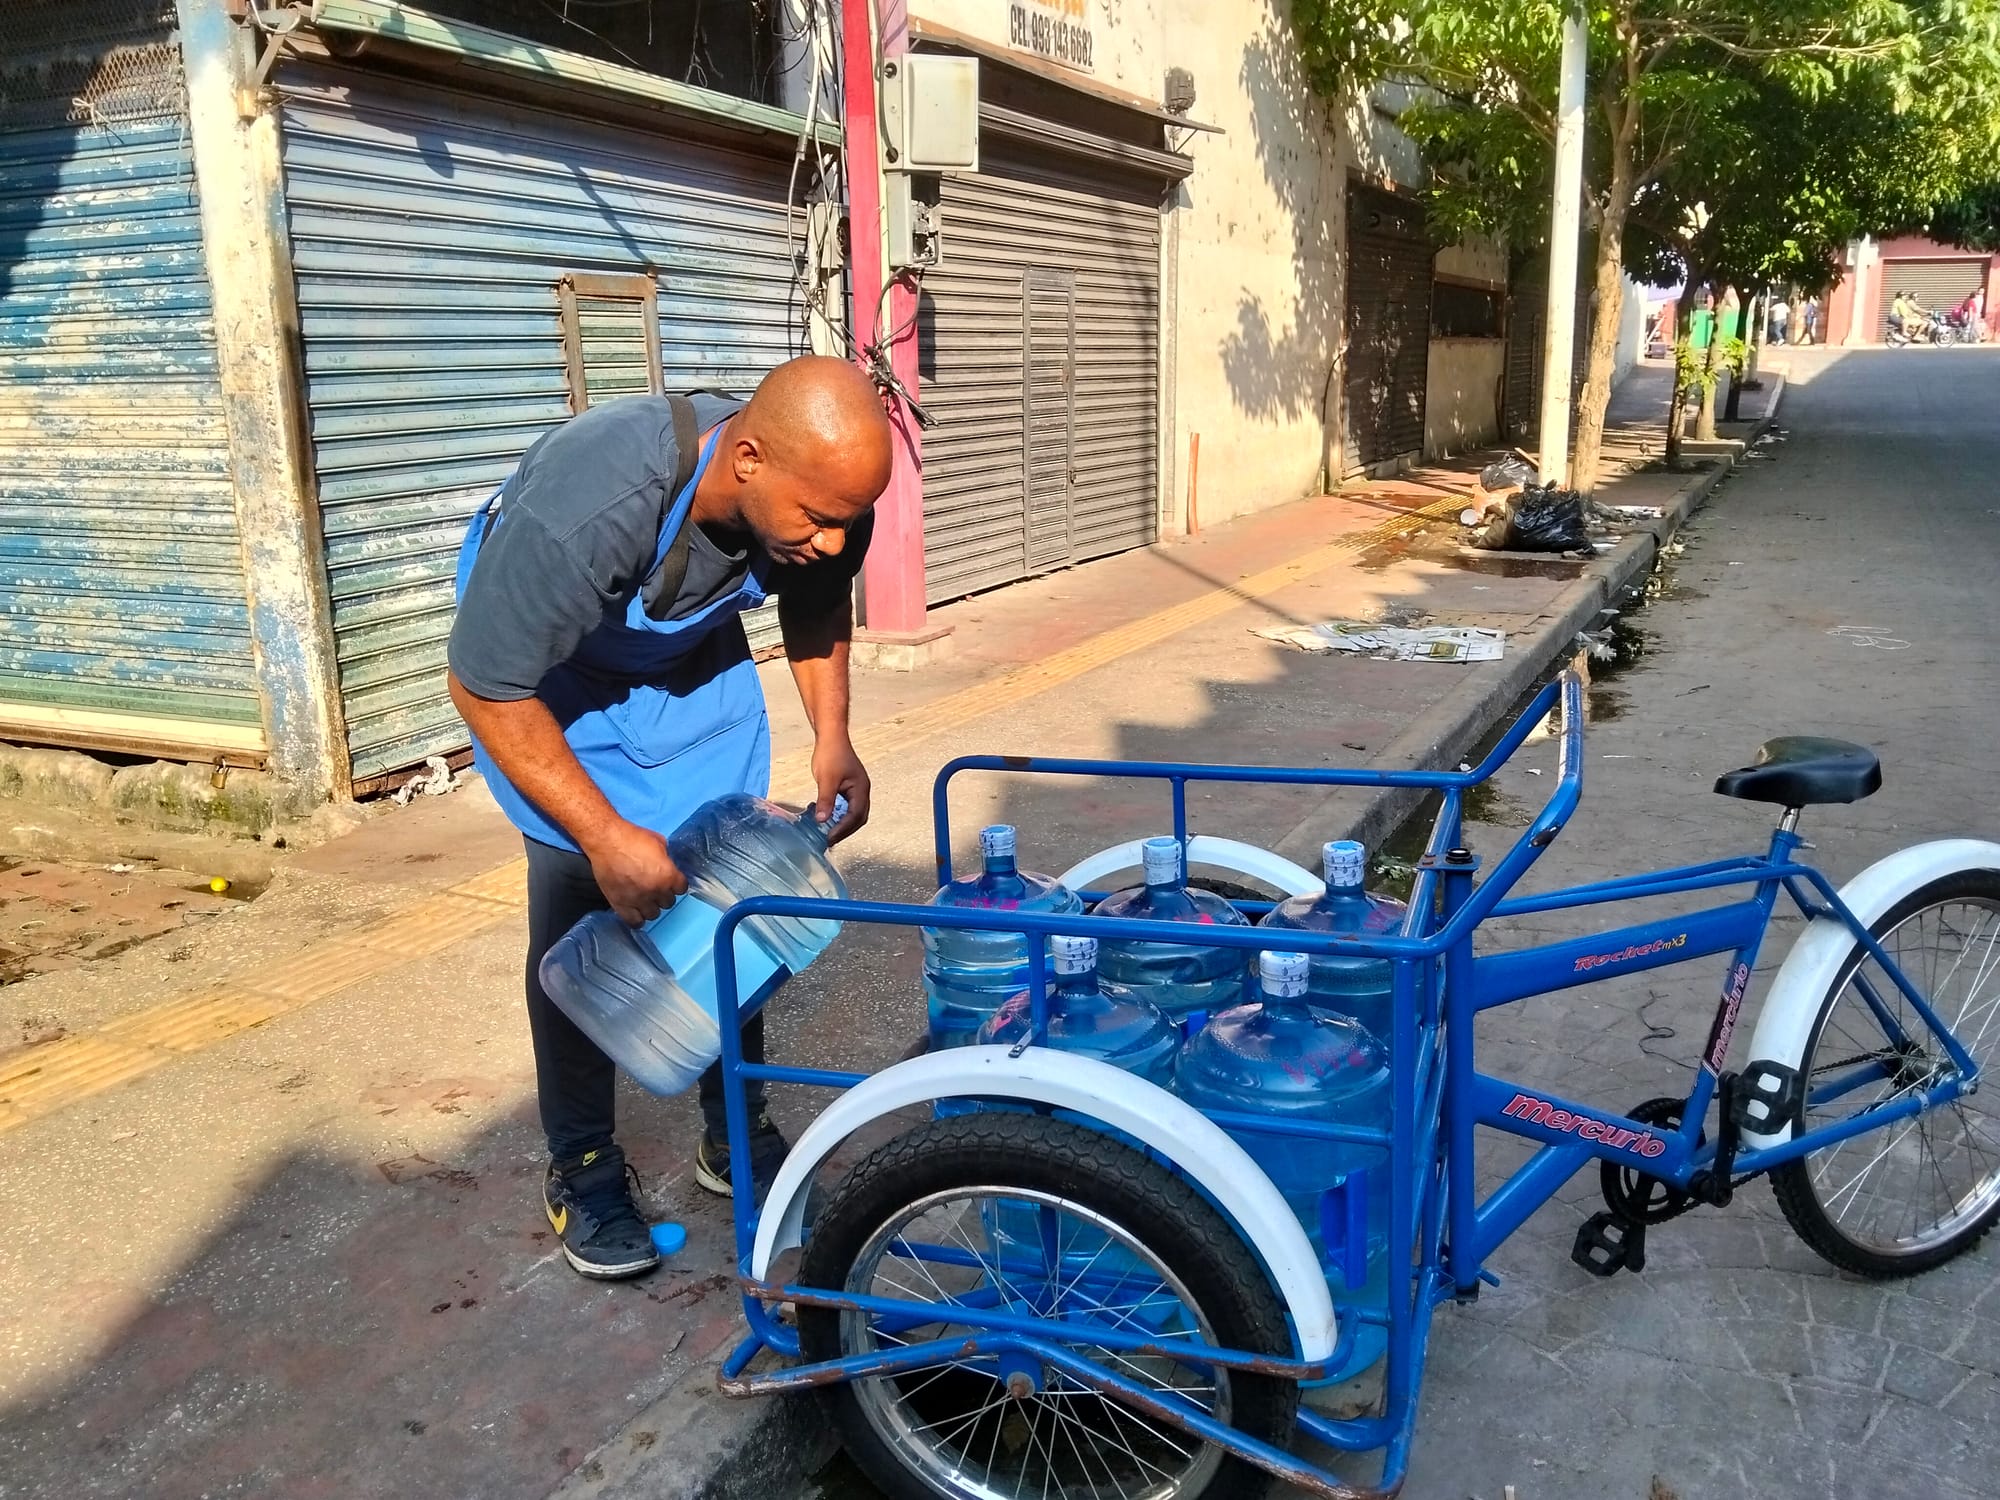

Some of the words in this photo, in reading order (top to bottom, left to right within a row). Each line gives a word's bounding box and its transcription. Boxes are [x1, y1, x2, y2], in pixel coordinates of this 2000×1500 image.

[1011, 4, 1030, 48] CEL.
[1032, 11, 1050, 55] 993
[1053, 20, 1068, 60] 143
[1071, 25, 1093, 67] 6682
